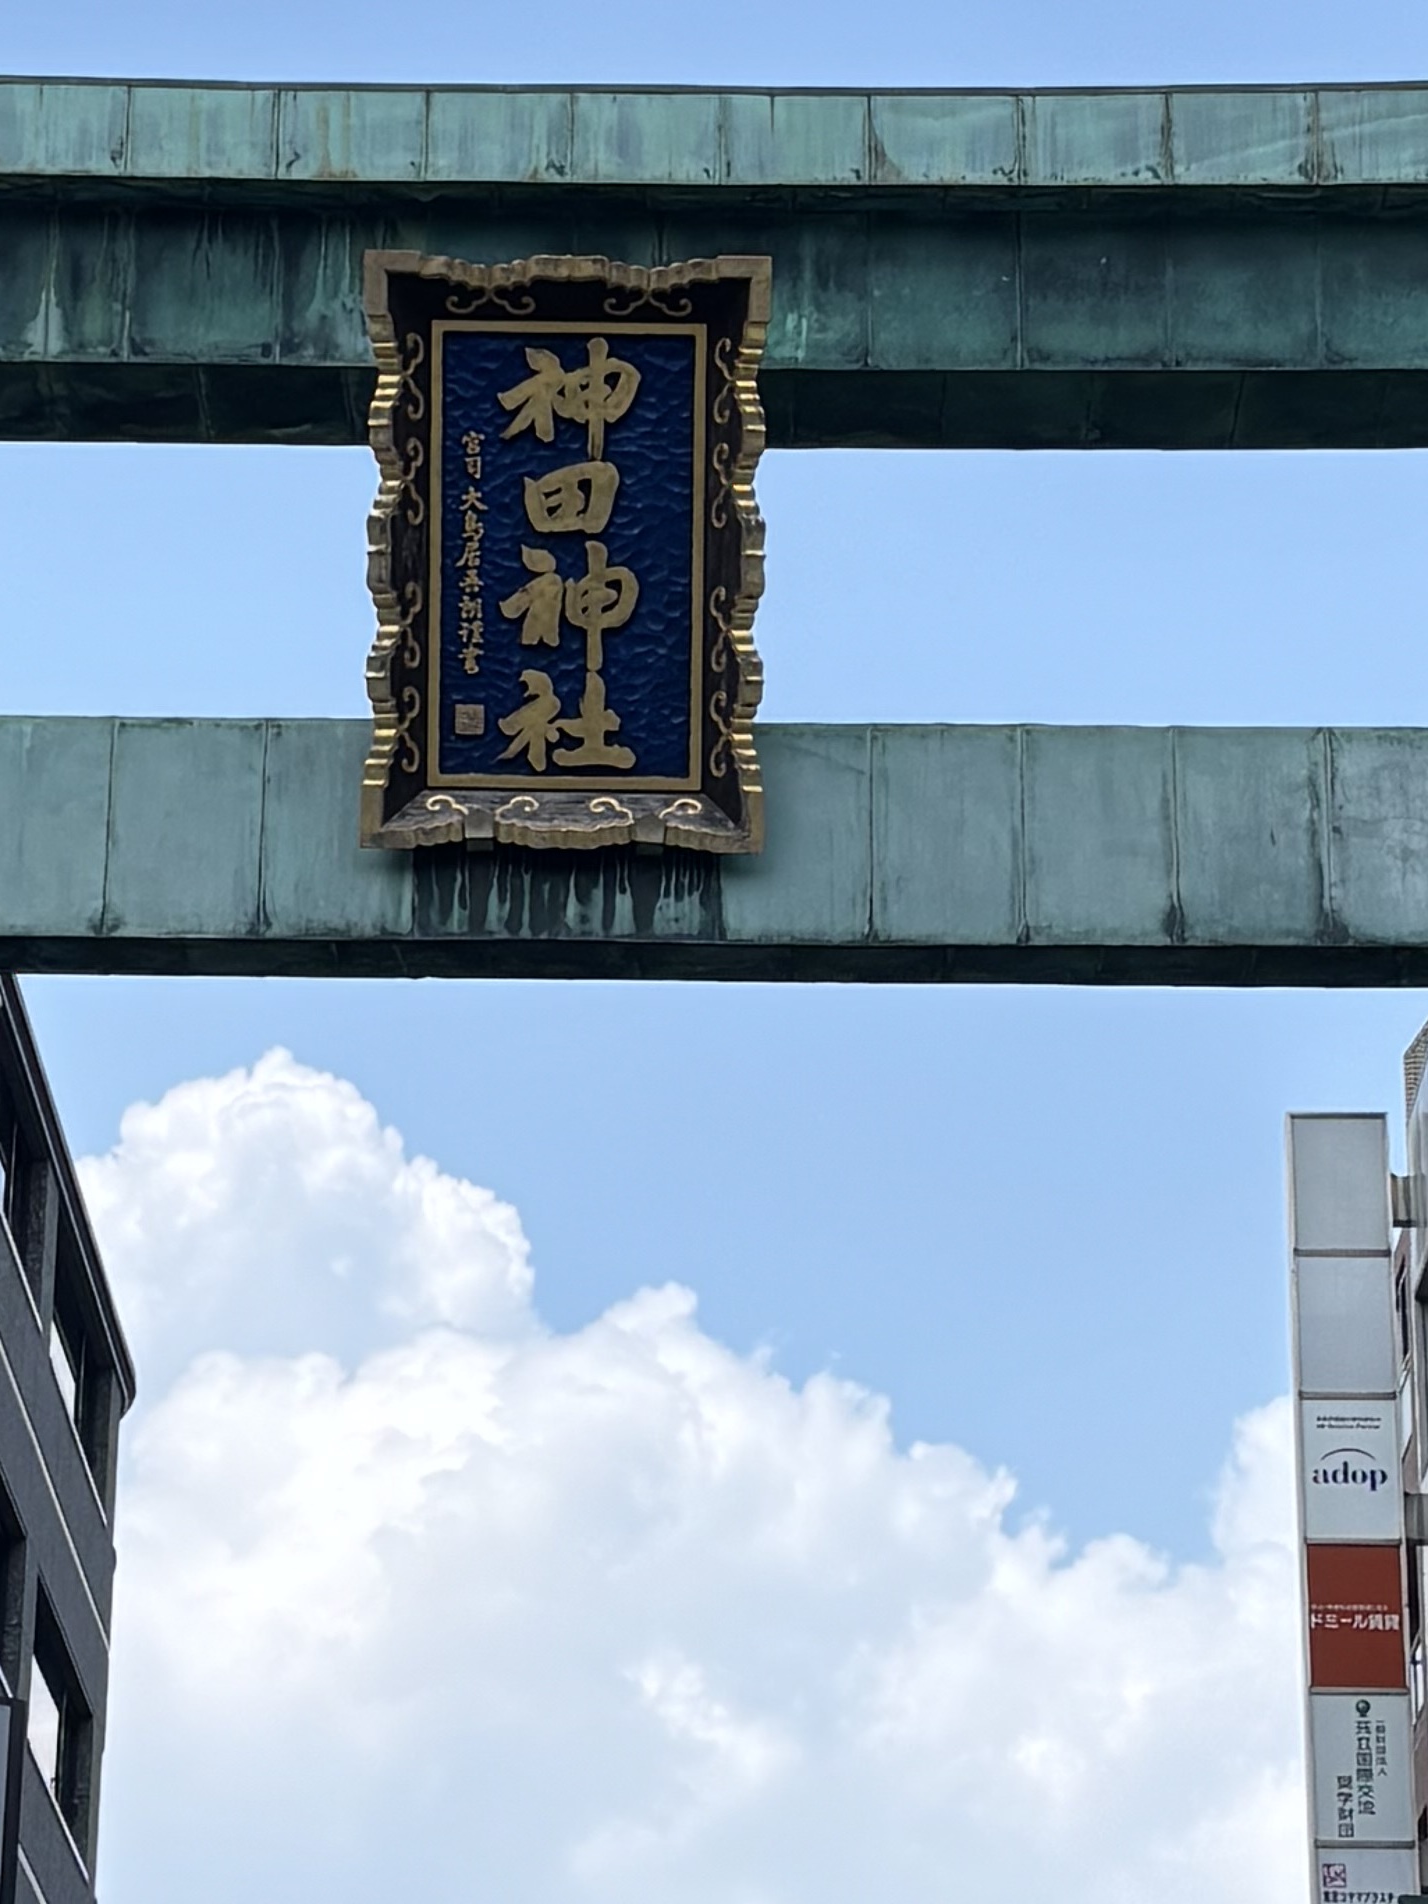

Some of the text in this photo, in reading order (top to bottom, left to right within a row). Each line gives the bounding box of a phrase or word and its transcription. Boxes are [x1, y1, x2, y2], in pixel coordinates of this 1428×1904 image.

[497, 337, 640, 772] 神田神社
[1312, 1461, 1388, 1491] adop
